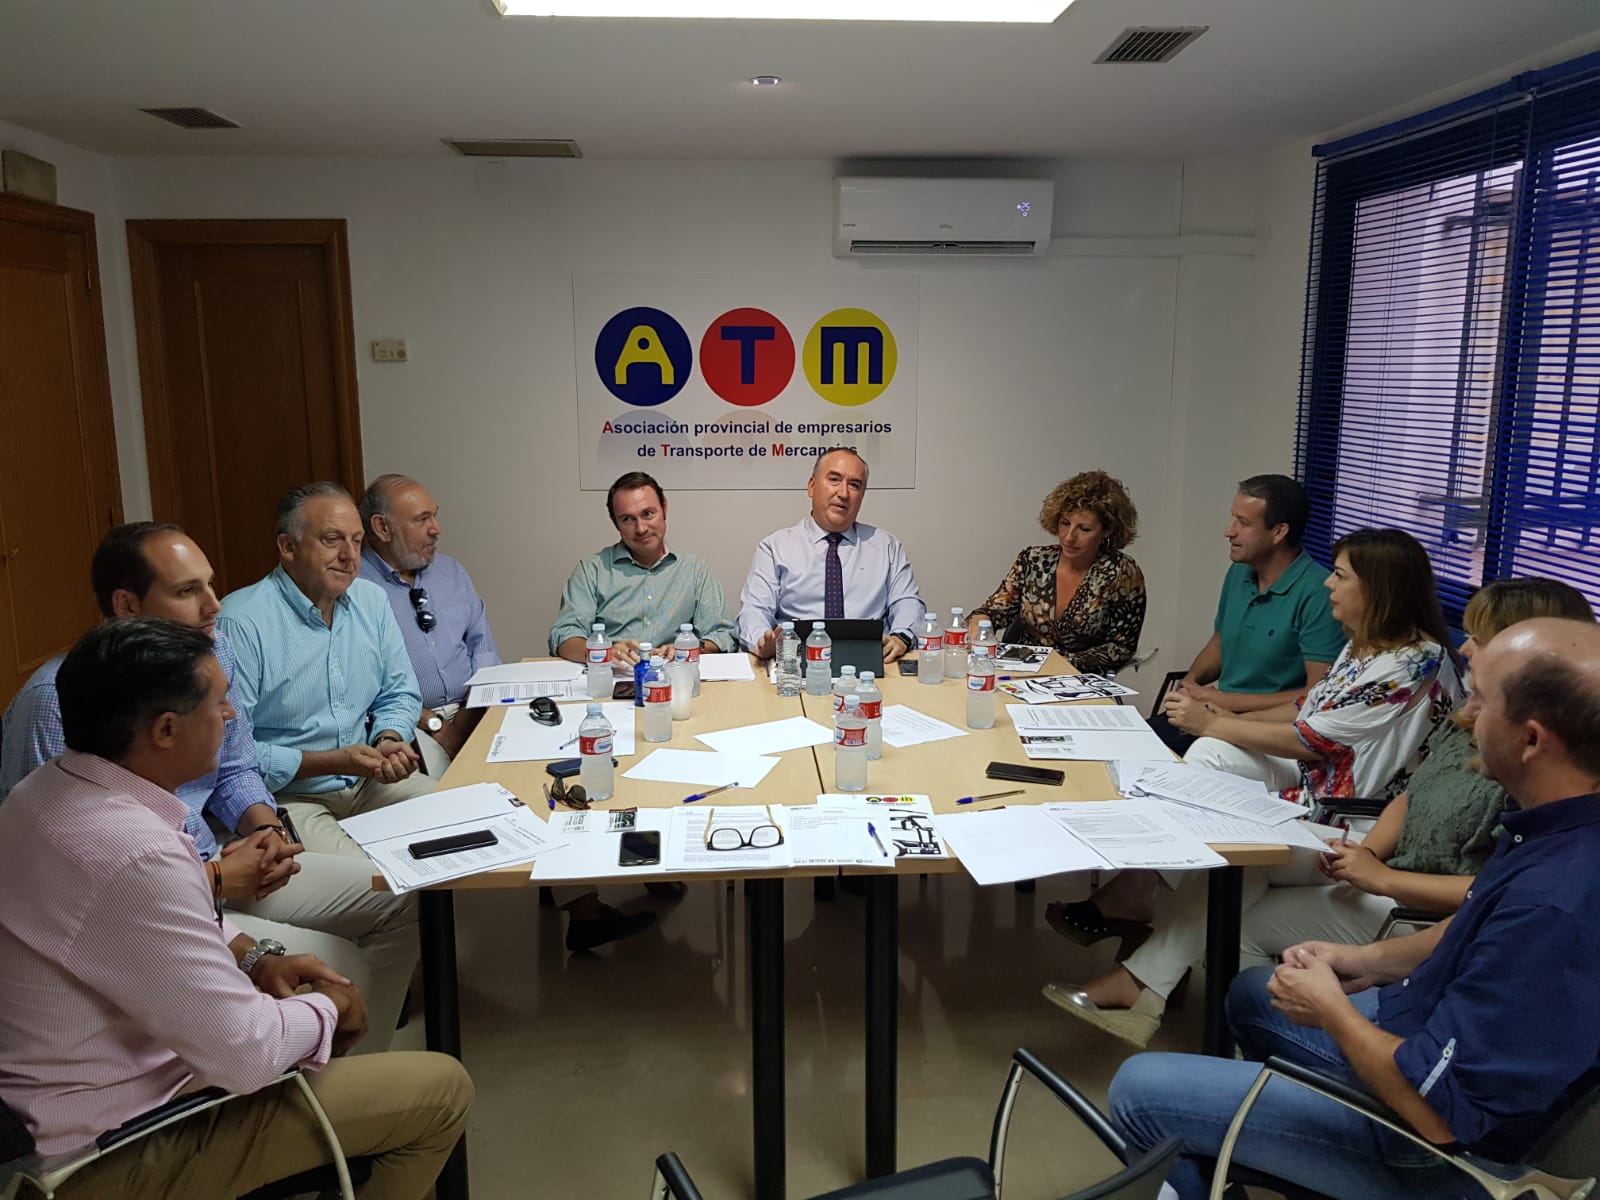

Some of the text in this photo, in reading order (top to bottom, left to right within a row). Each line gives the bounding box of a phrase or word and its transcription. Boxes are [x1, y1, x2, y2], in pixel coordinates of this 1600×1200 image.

[602, 420, 892, 437] Asociación provincial de empresarios
[637, 444, 657, 457] de
[660, 443, 744, 460] Transporte
[749, 444, 767, 457] de
